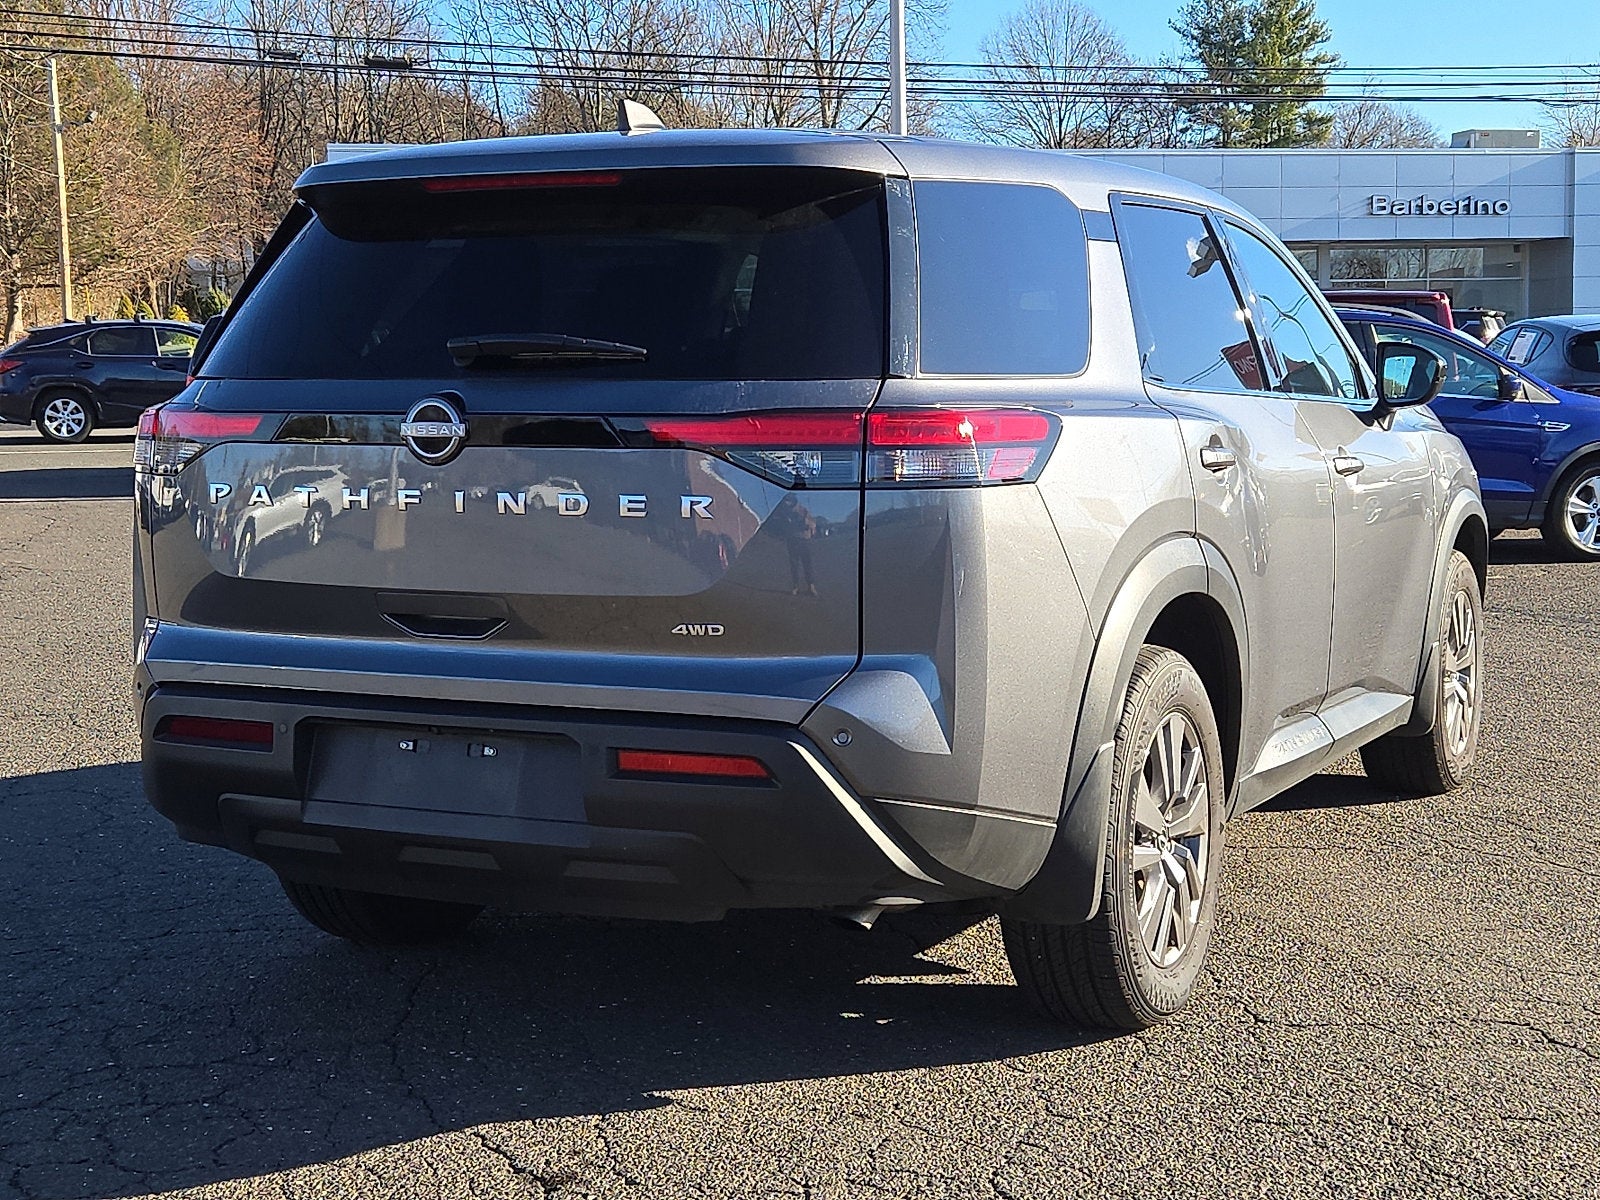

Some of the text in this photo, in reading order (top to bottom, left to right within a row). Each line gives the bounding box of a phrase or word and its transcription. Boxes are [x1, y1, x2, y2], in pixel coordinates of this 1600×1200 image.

[1369, 193, 1512, 216] Barberino
[401, 423, 465, 436] NISSAN
[208, 482, 714, 519] PATHFINDER
[671, 623, 726, 637] 4WD
